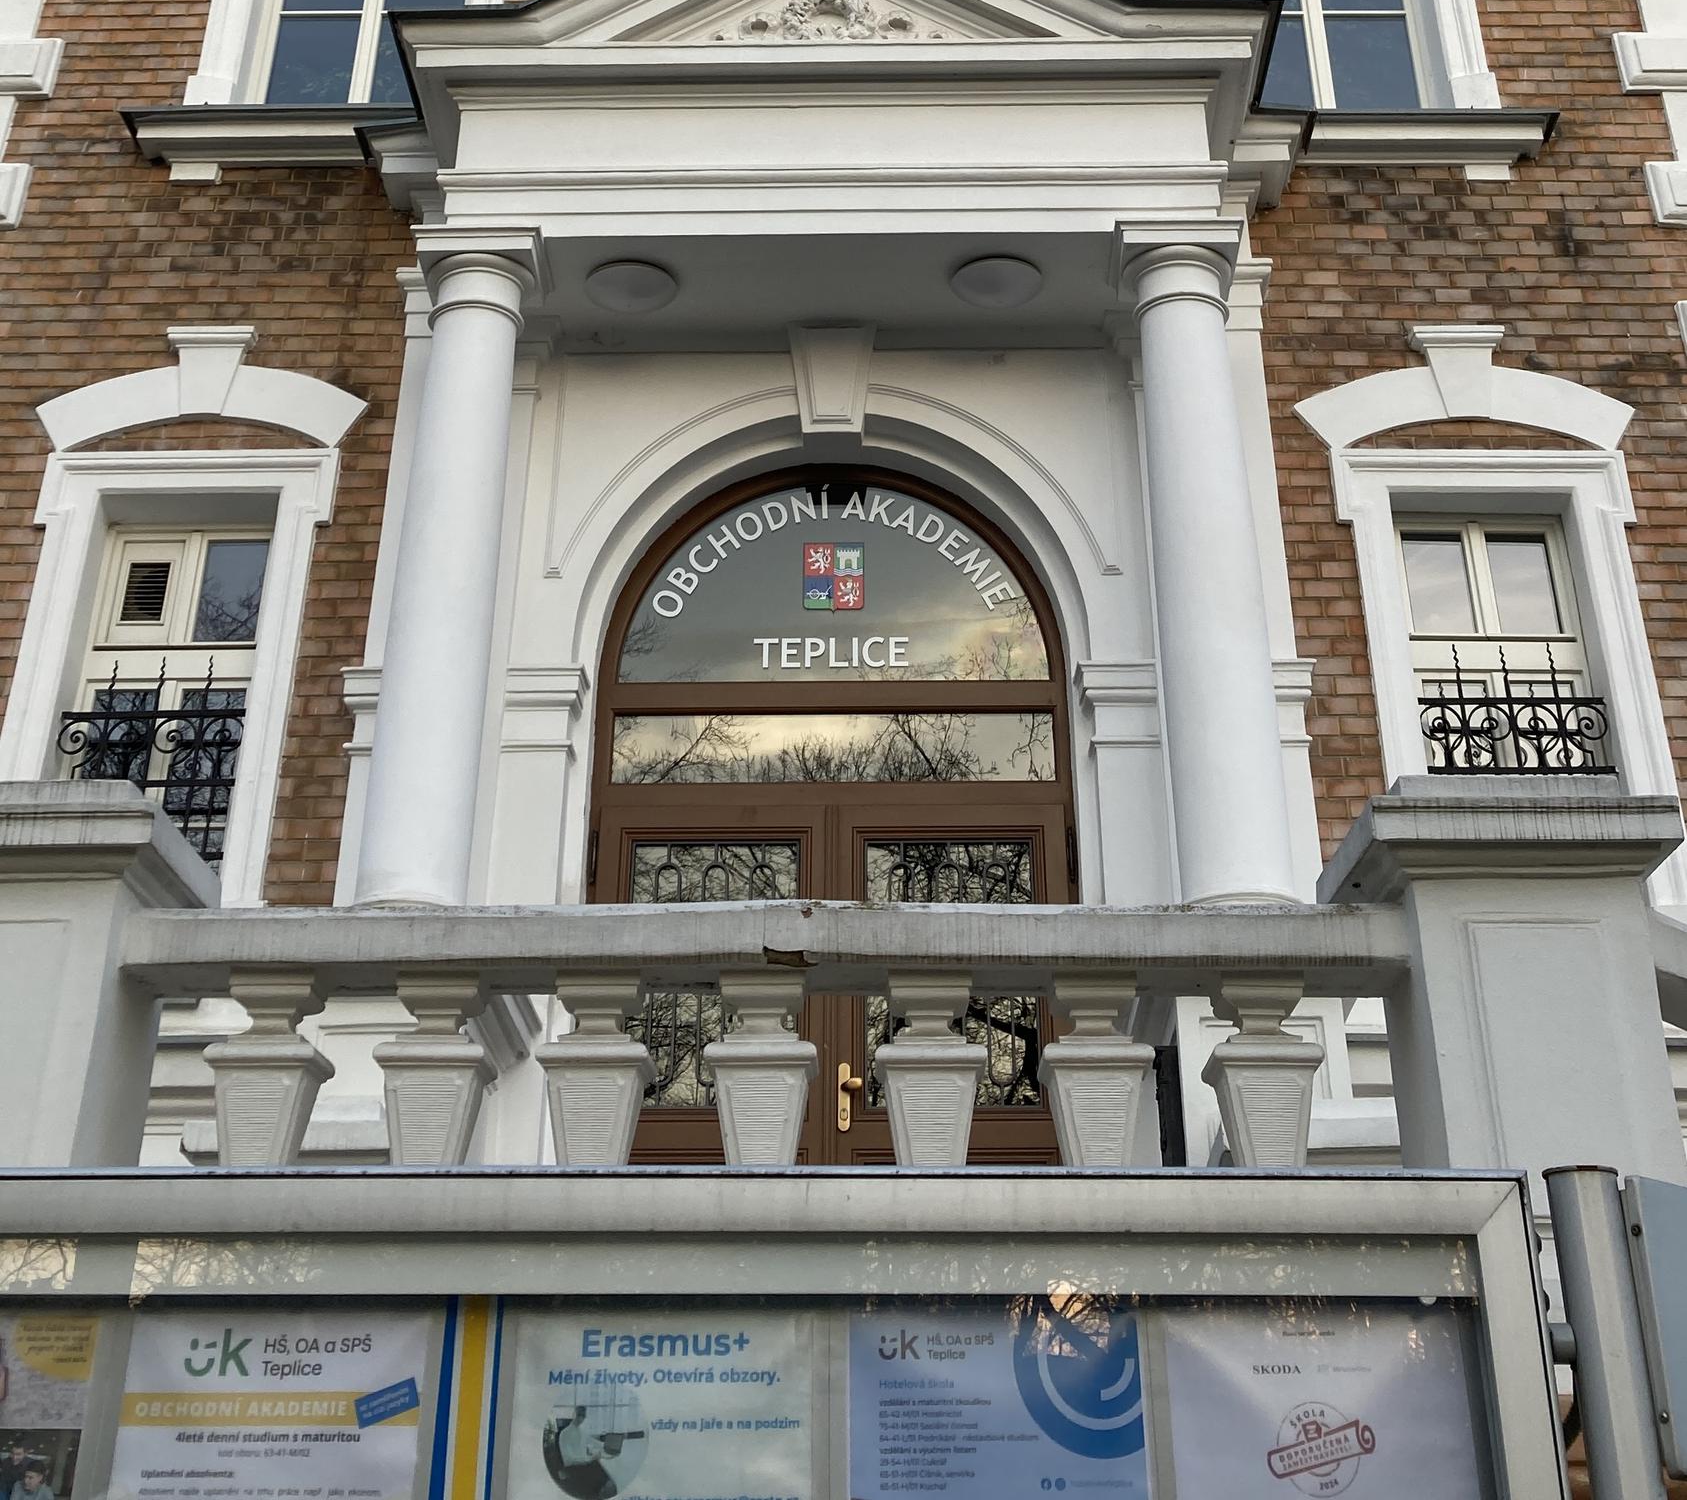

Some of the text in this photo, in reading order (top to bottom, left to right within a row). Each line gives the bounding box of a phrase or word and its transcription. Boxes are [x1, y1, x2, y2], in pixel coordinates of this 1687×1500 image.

[652, 484, 1016, 618] OBCHODNÍ AKADEMIE
[754, 636, 909, 669] TEPLICE
[264, 1334, 372, 1355] HŠ, OA a SPŠ
[582, 1330, 750, 1358] Erasmus+
[945, 1335, 962, 1346] OA
[964, 1336, 972, 1345] a
[974, 1332, 994, 1346] SPŠ
[927, 1349, 966, 1362] Teplice
[262, 1360, 322, 1380] Teplice
[549, 1368, 780, 1386] Mění životy. Otevírá obzory.
[879, 1379, 926, 1389] Hotelová
[135, 1397, 240, 1418] OBCHODNÍ
[246, 1400, 348, 1417] AKADEMIE
[651, 1417, 800, 1432] vždy na jaře a na podzim
[206, 1431, 240, 1442] denní
[242, 1431, 289, 1442] studium
[292, 1433, 298, 1442] s
[301, 1432, 360, 1442] maturitou
